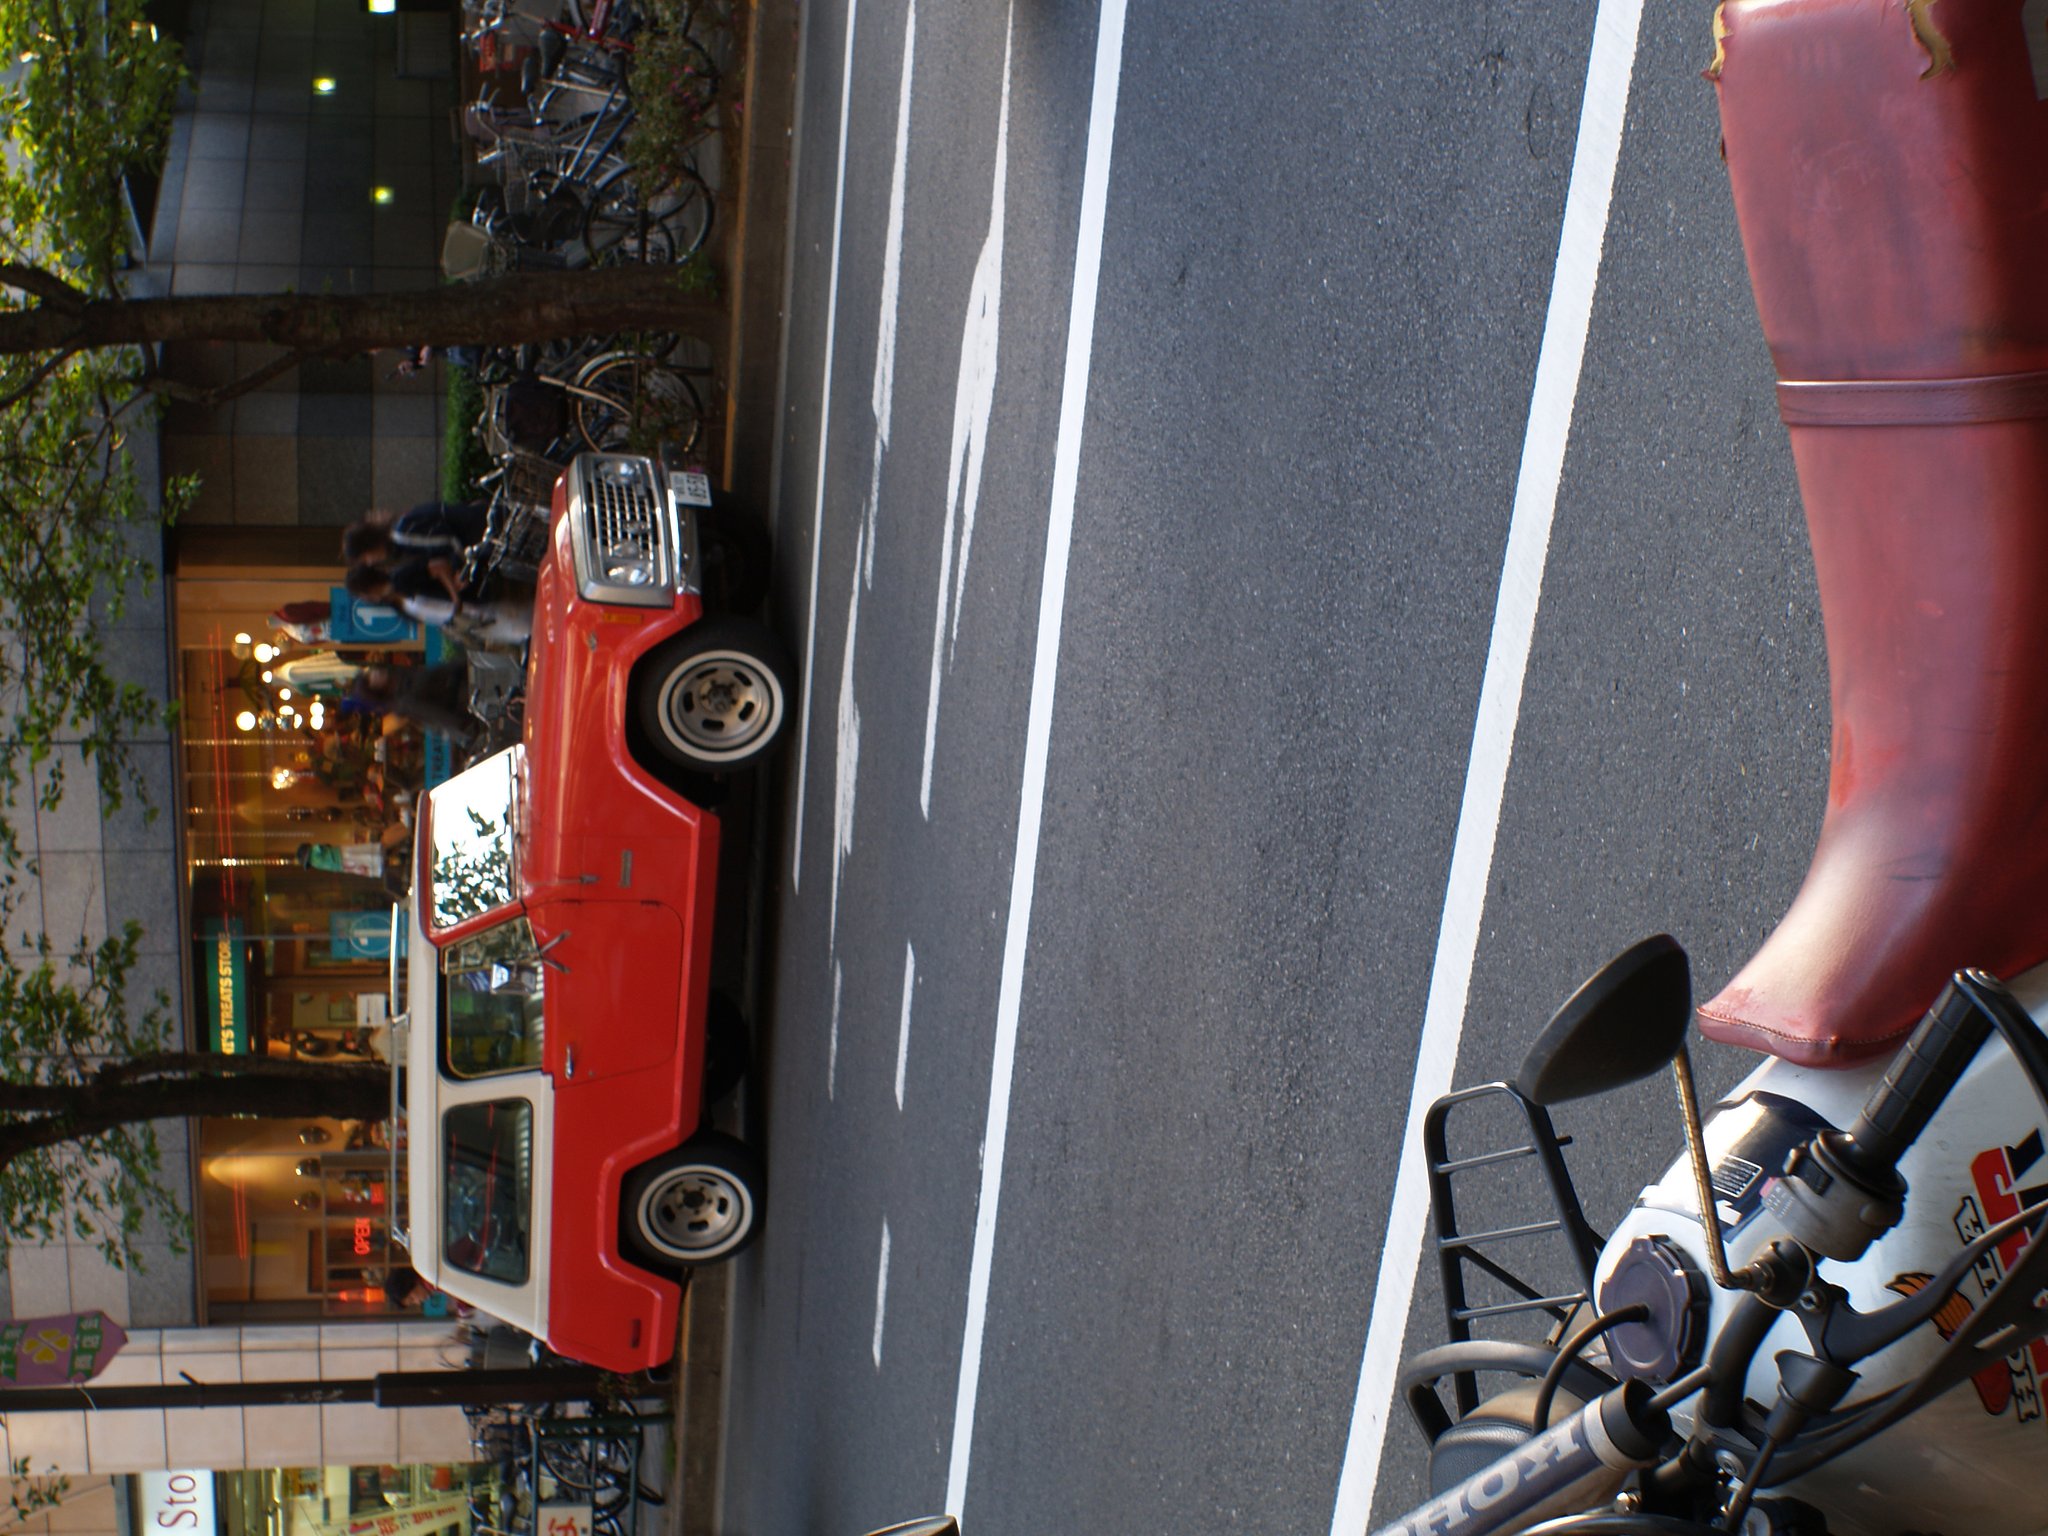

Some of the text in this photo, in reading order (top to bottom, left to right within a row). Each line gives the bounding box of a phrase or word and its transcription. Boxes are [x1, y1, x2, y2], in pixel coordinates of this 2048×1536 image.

[218, 977, 234, 1027] TREATS
[354, 1217, 371, 1255] OPEN
[157, 1472, 197, 1528] Sto
